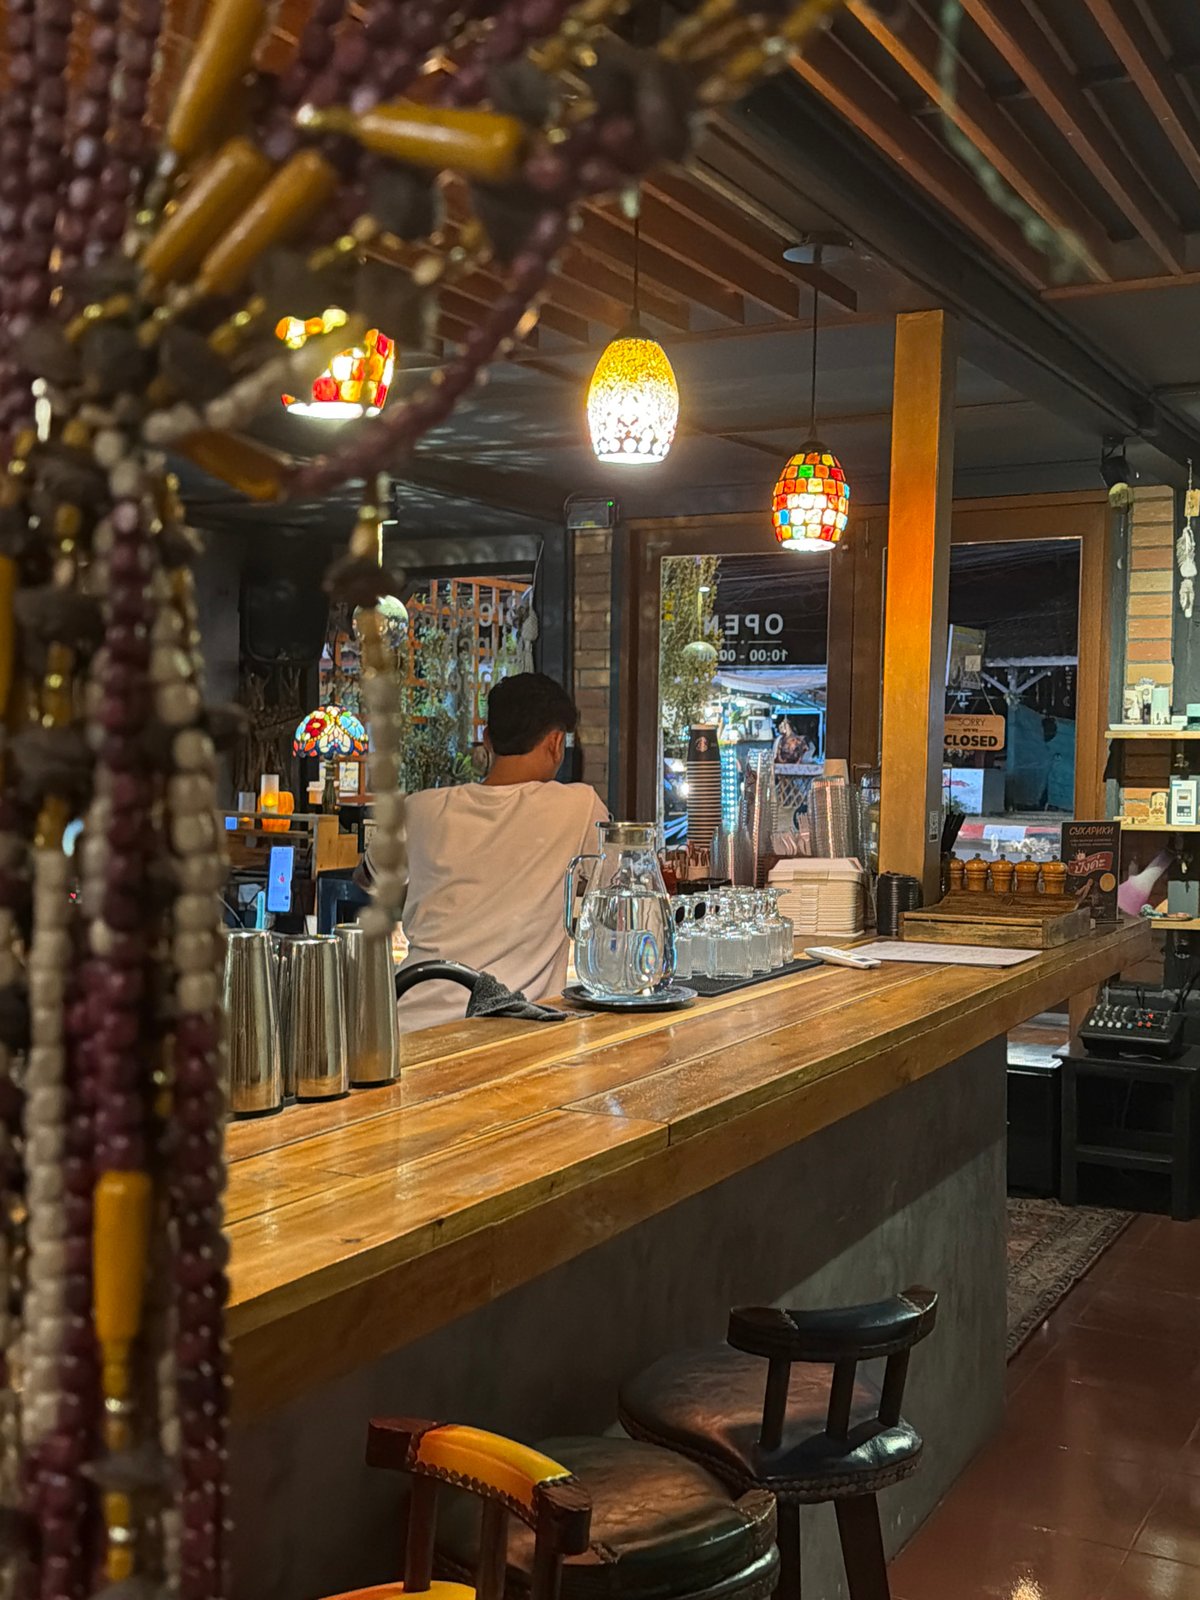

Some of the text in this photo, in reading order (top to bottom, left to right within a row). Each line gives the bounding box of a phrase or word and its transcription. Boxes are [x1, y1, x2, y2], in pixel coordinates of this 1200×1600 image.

[957, 717, 985, 727] SORRY
[944, 734, 998, 747] CLOSED
[1069, 826, 1114, 837] СУХАРИКИ
